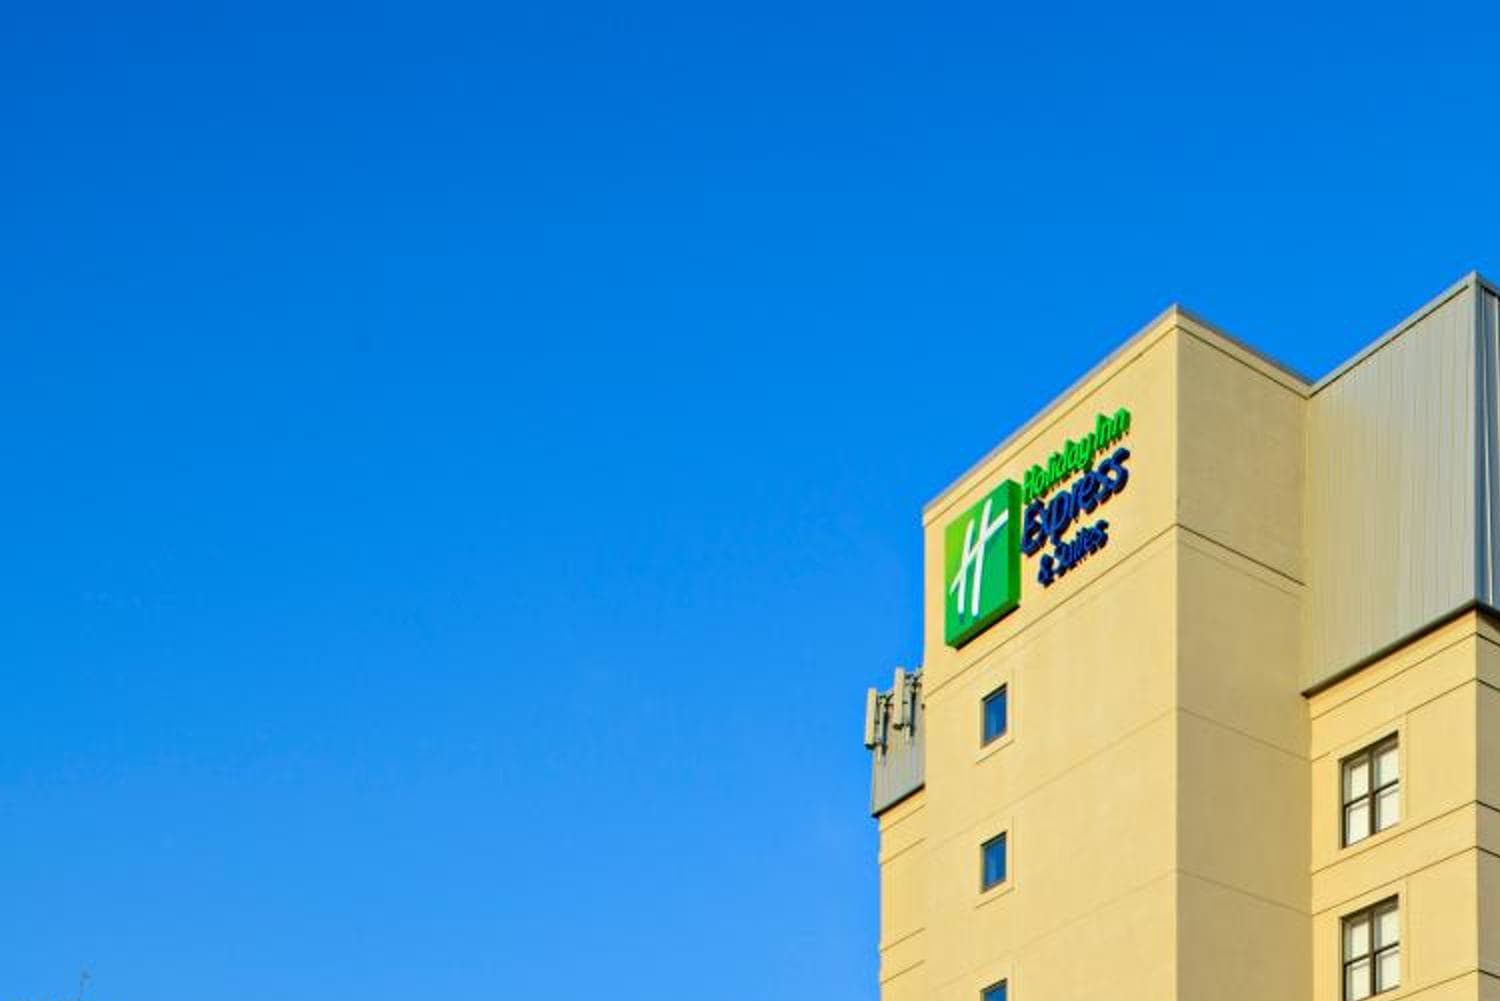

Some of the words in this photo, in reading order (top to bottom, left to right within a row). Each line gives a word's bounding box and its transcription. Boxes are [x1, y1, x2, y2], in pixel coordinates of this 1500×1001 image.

[1022, 447, 1130, 556] Express
[1023, 432, 1095, 505] Holiday
[1095, 408, 1130, 452] Inn
[1038, 554, 1055, 587] &
[1053, 519, 1109, 578] Suites
